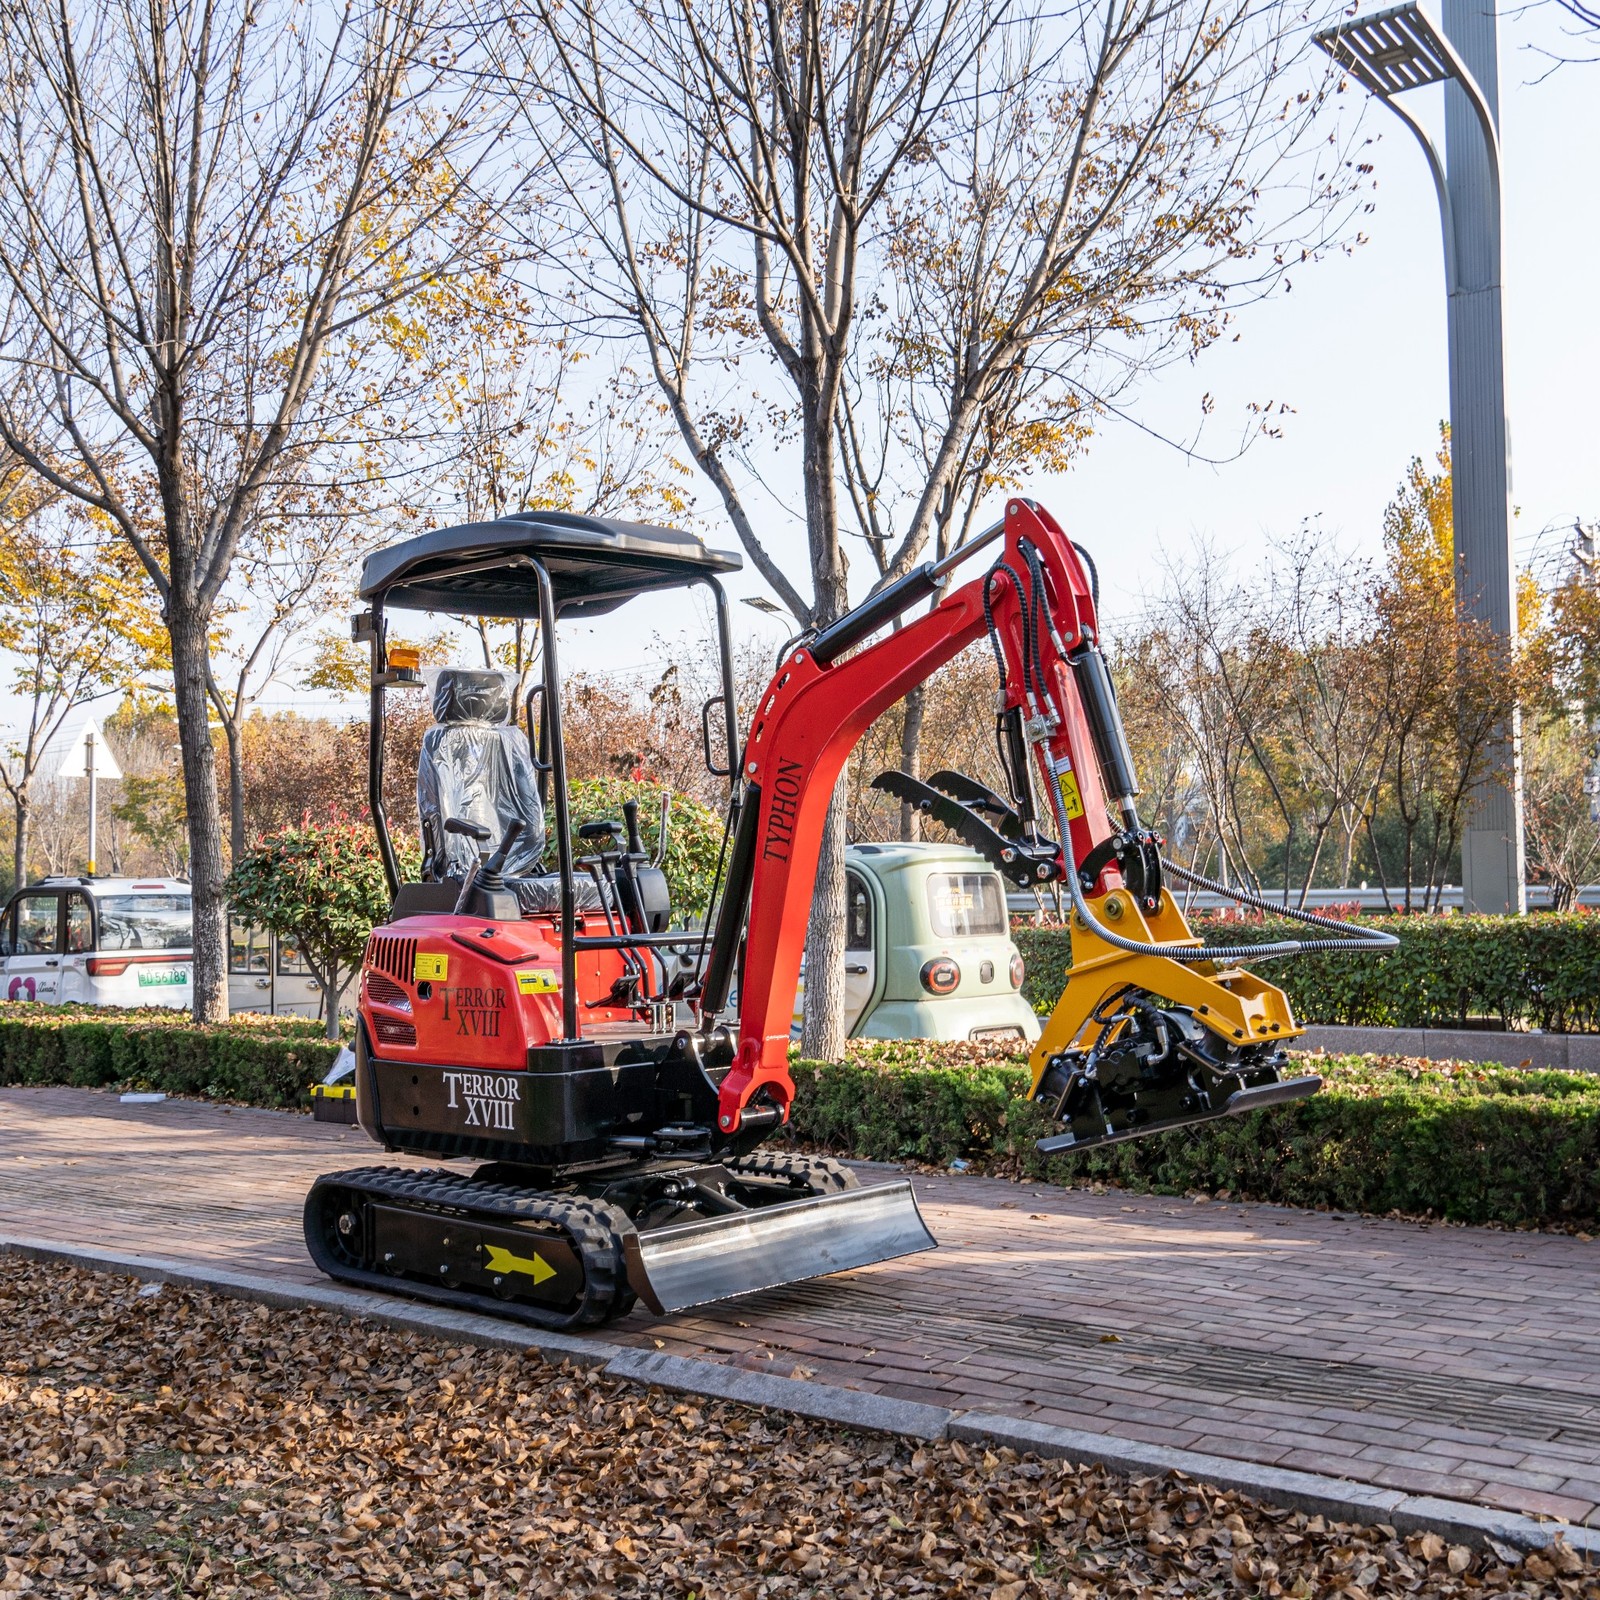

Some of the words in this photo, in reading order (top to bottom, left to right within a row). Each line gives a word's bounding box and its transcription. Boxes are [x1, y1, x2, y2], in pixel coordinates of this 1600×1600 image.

[763, 756, 803, 863] TYPHON
[439, 987, 506, 1021] TERROR
[457, 1009, 500, 1037] XVIII
[443, 1071, 521, 1108] TERROR
[464, 1096, 515, 1130] XVIII
